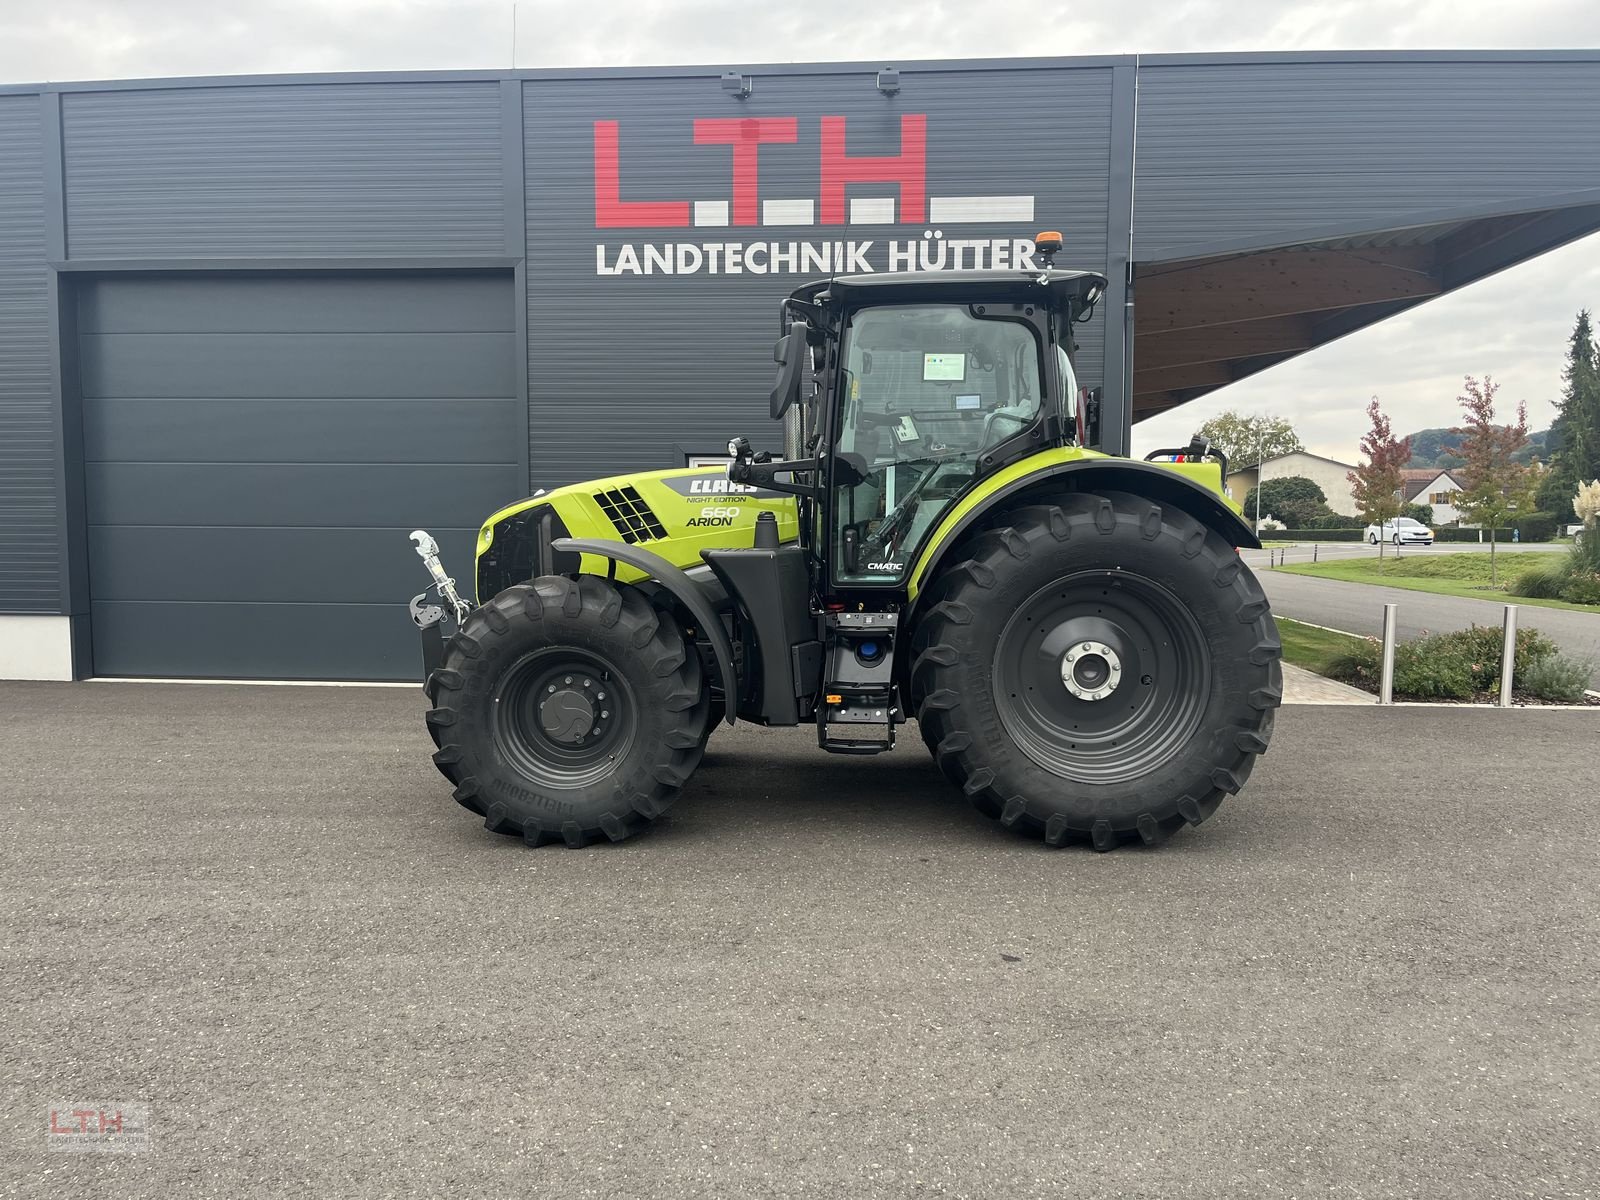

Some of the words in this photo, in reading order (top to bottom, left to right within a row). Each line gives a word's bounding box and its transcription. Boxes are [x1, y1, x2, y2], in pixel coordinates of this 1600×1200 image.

[594, 114, 927, 228] LTH
[595, 241, 874, 276] LANDTECHNIK
[889, 230, 1037, 272] HÜTTER
[700, 506, 740, 518] 660
[686, 517, 733, 527] ARION
[867, 562, 904, 571] CMATIC
